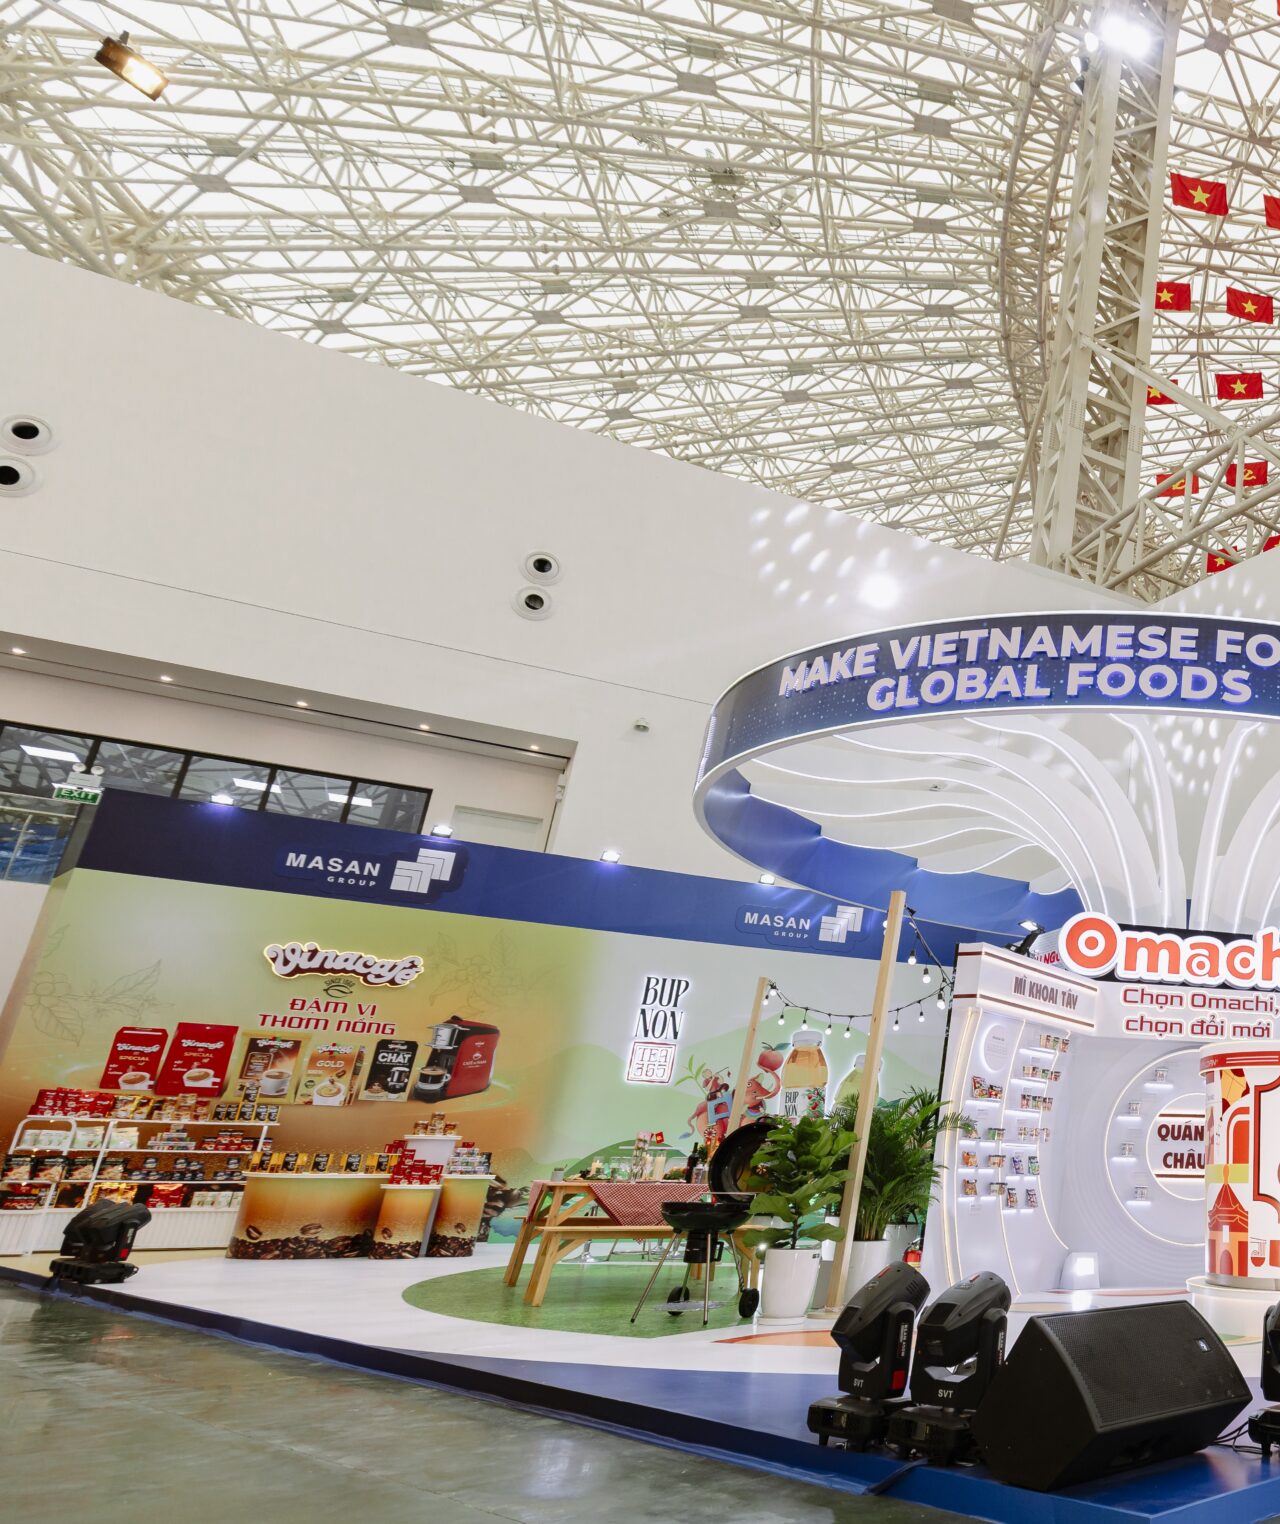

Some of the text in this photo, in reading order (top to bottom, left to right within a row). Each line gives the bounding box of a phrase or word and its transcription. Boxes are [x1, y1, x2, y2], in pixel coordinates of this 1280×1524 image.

[779, 642, 880, 697] MAKE
[890, 624, 1199, 671] VIETNAMESE
[867, 663, 1252, 711] GLOBAL FOODS
[61, 788, 95, 800] EXIT
[285, 852, 381, 877] MASAN
[327, 876, 376, 887] GROUP
[744, 911, 811, 931] MASAN
[773, 931, 808, 939] GROUP
[642, 976, 690, 1008] BUP
[1014, 975, 1078, 1010] MÌ KHOAI TÂY
[1123, 988, 1280, 1016] Chọn Omachi,
[357, 1003, 377, 1017] VỊ
[635, 1008, 684, 1040] NON
[1125, 1015, 1272, 1038] chọn đổi mới
[316, 1060, 345, 1068] GOLD
[639, 1047, 669, 1063] TEA
[1157, 1120, 1204, 1141] QUÁN
[1163, 1148, 1205, 1169] CHÂU
[853, 1378, 864, 1388] SVT
[938, 1389, 954, 1398] SVT
